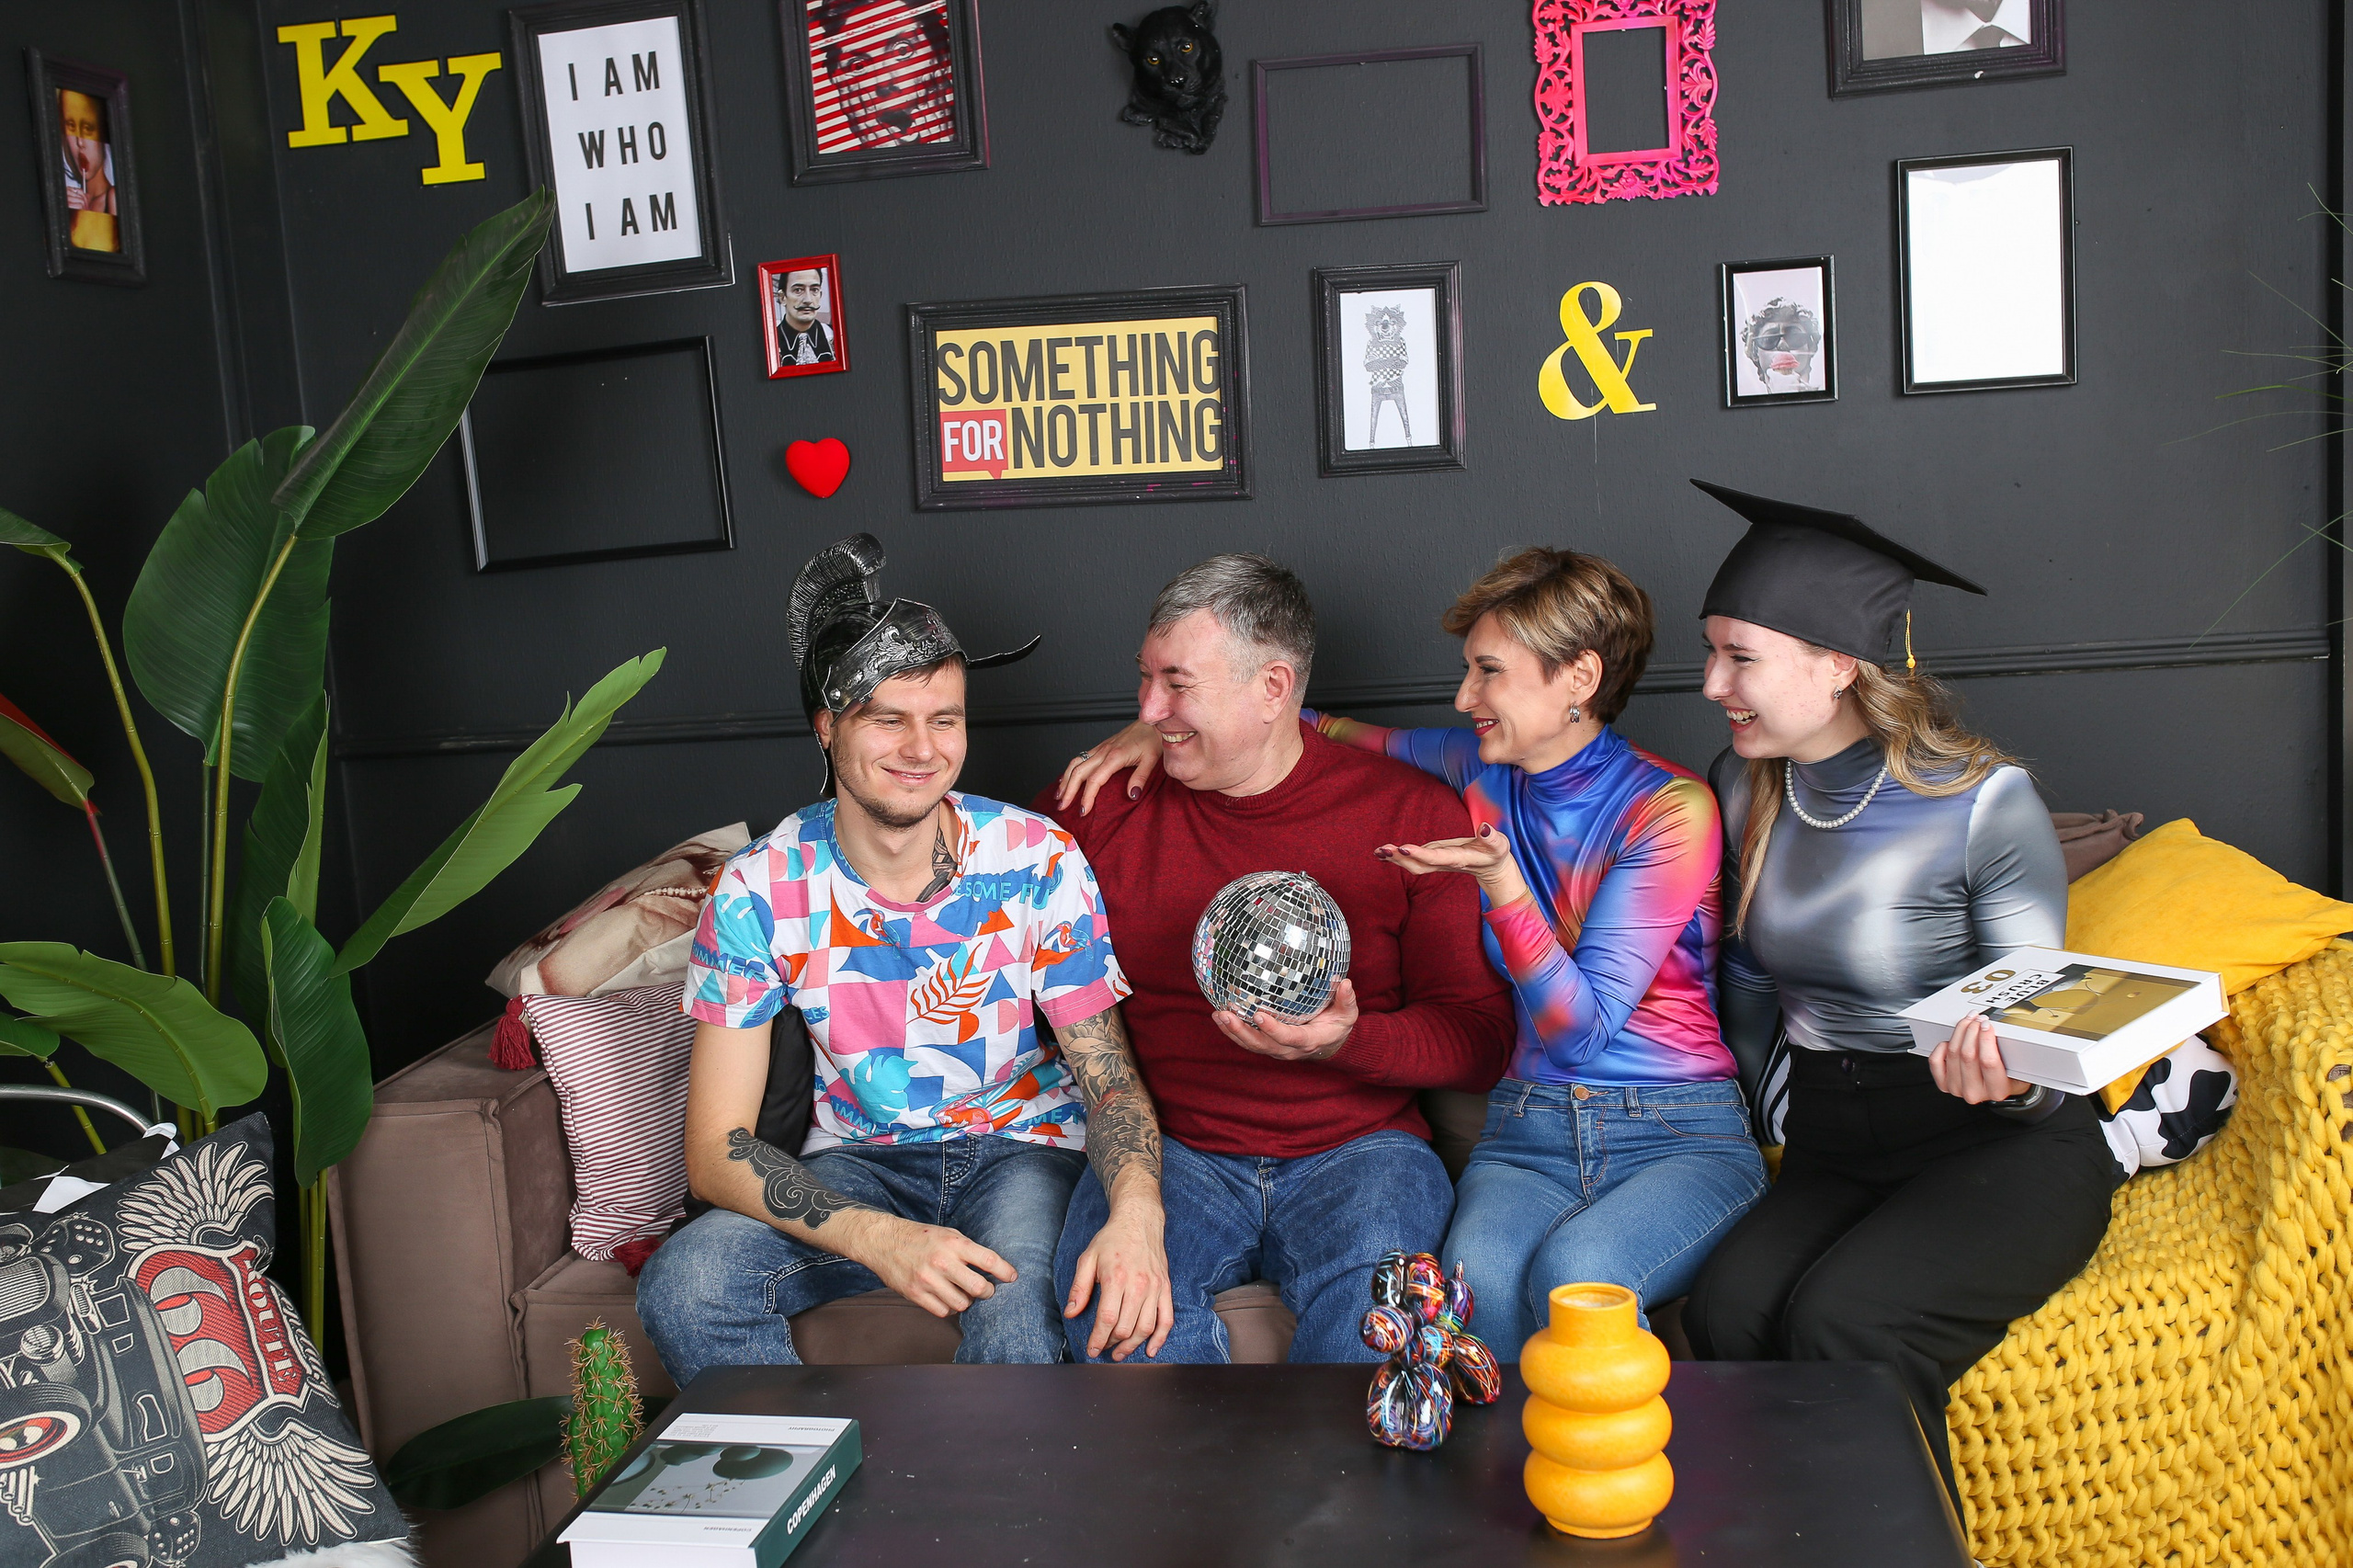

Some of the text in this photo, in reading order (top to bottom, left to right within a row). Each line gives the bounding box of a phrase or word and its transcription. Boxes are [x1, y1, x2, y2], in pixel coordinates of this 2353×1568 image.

[277, 14, 503, 186] KY
[568, 51, 660, 101] I AM
[578, 121, 666, 169] WHO
[585, 191, 677, 240] I AM
[937, 329, 1221, 405] SOMETHING
[943, 398, 1223, 470] FOR NOTHING
[692, 945, 769, 983] UMMER
[1961, 969, 2017, 994] 03
[1985, 974, 2042, 1004] CRUSH
[786, 1463, 836, 1535] COPENHAGEN
